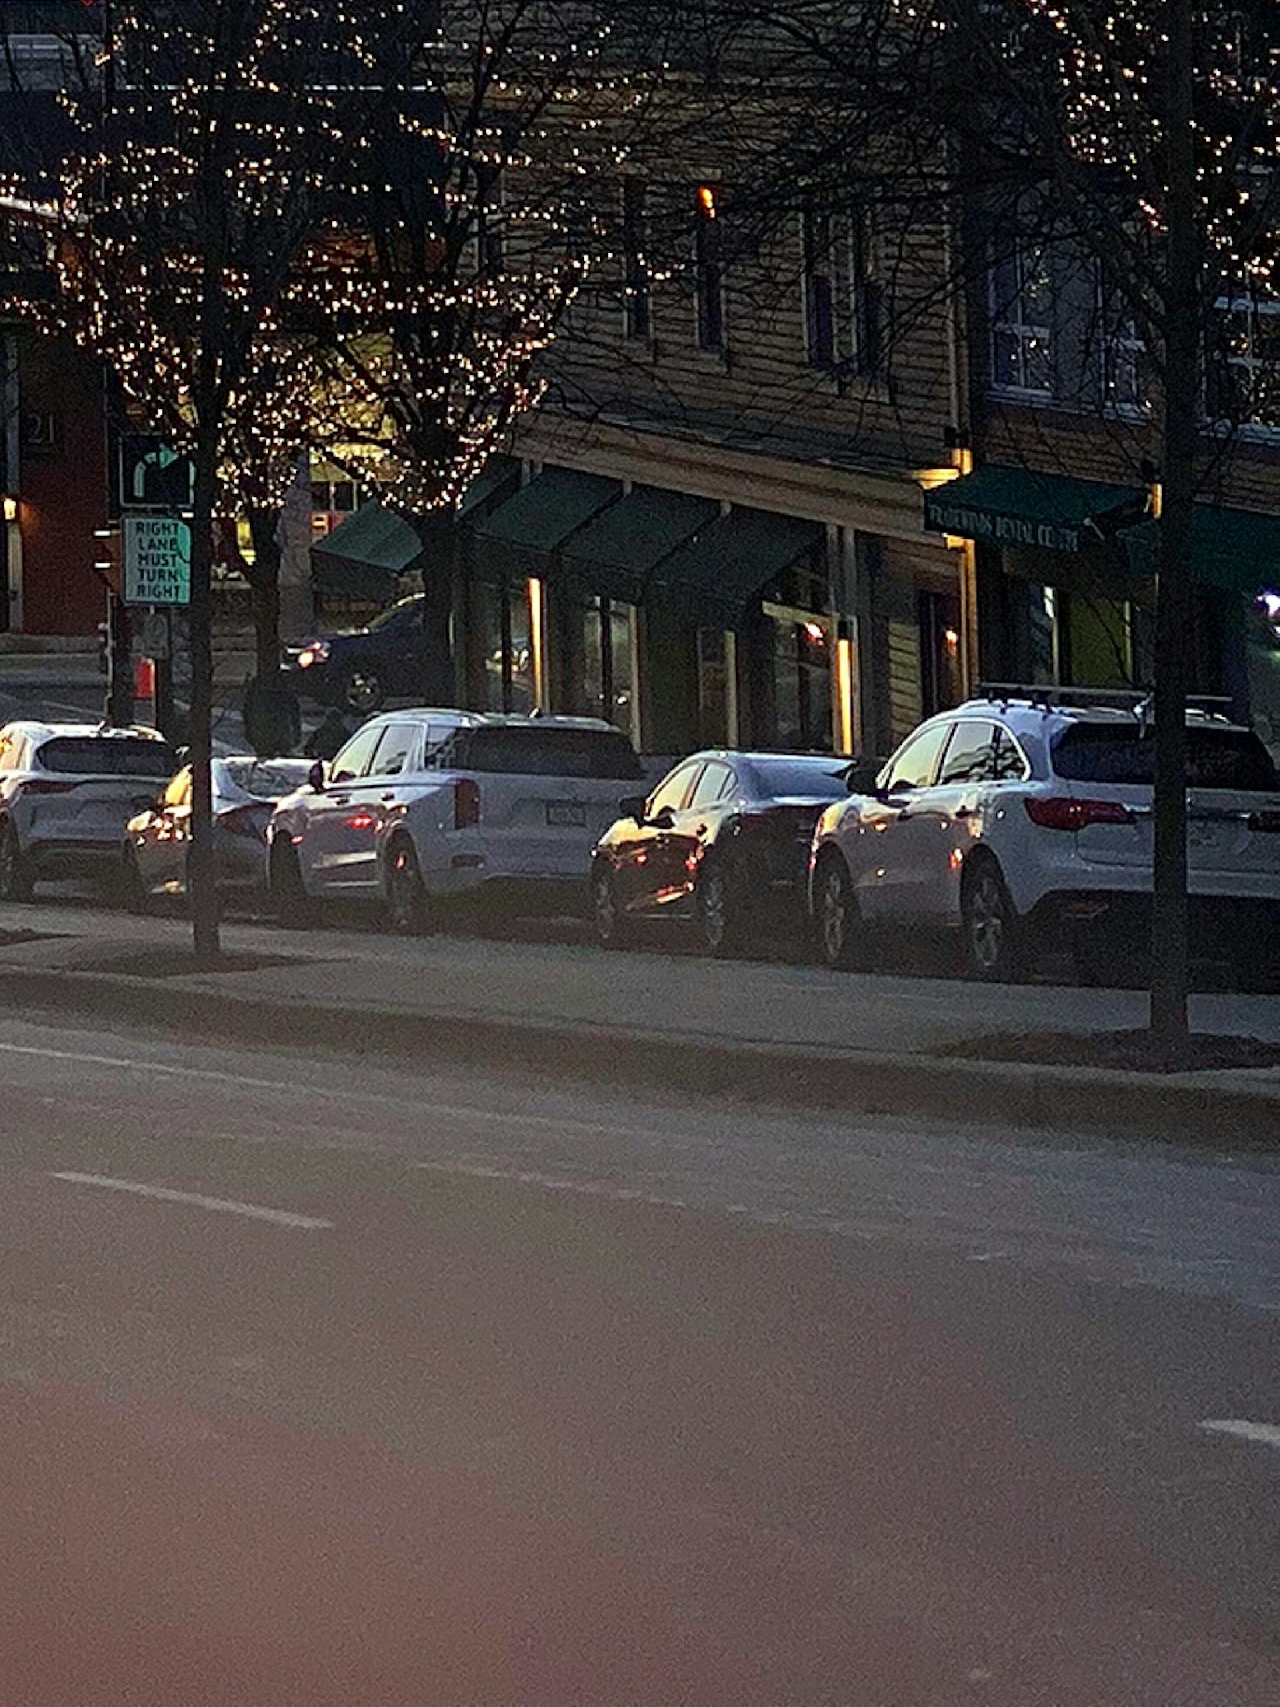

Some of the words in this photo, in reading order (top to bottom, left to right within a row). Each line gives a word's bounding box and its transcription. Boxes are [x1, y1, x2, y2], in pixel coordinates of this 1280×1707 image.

[134, 521, 179, 535] RIGHT
[138, 538, 178, 551] LANE
[138, 553, 177, 567] MUST
[138, 568, 179, 582] TURN
[136, 584, 181, 598] RIGHT
